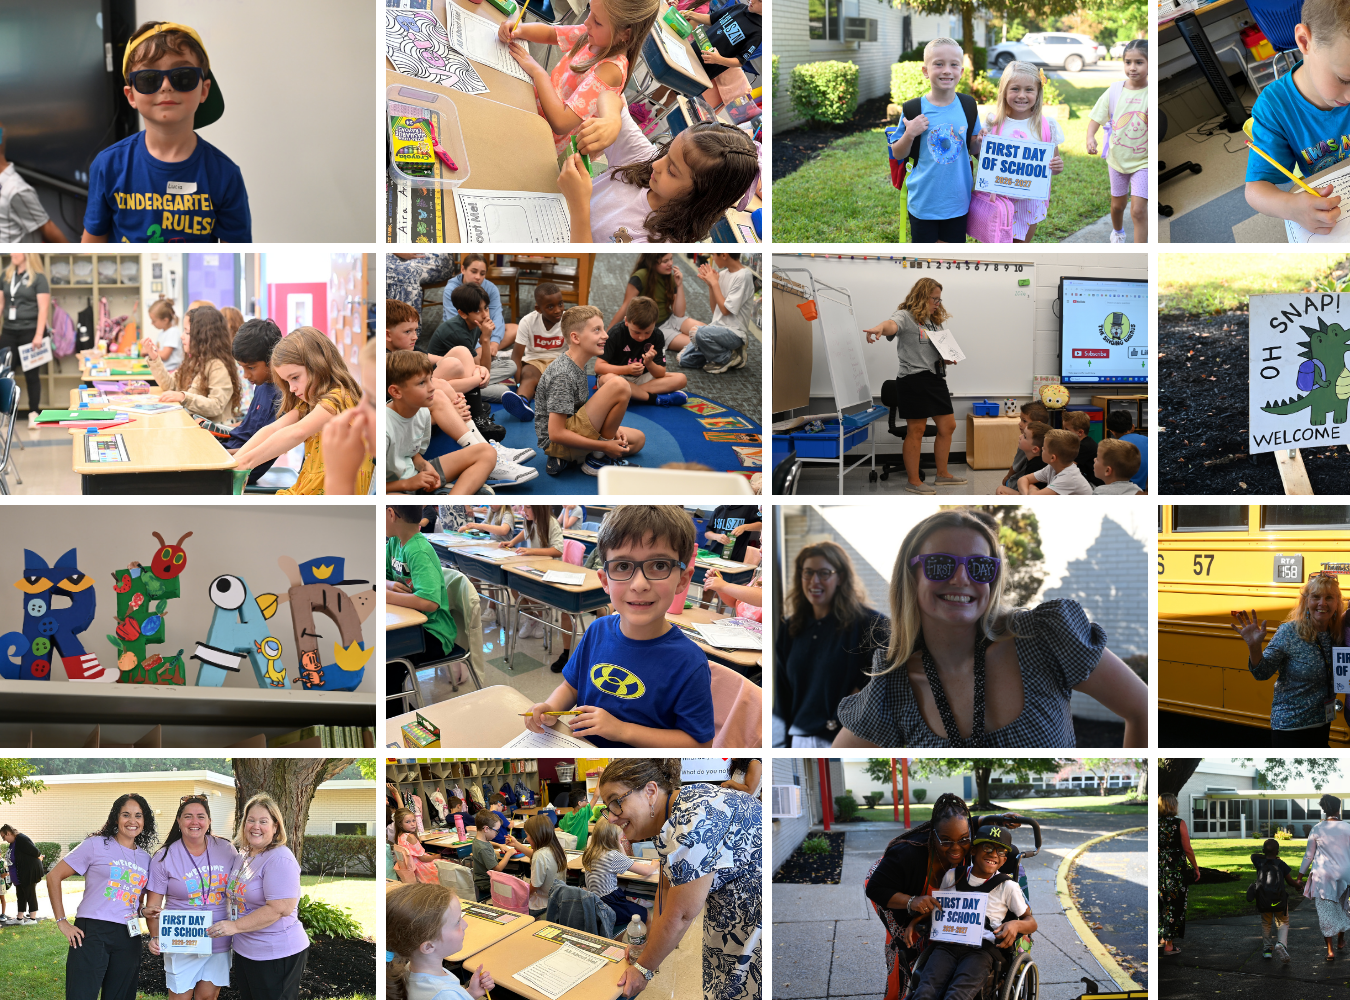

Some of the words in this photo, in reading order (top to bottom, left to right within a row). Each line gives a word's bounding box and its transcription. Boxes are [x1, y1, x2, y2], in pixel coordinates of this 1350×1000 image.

[985, 141, 1020, 158] FIRST
[1022, 147, 1046, 162] DAY
[1308, 139, 1339, 160] WAS
[982, 157, 998, 171] OF
[1000, 160, 1047, 178] SCHOOL
[995, 176, 1032, 188] 2026-2027
[162, 211, 215, 234] RULES!
[398, 208, 408, 234] Aira
[936, 261, 941, 269] 2
[956, 262, 960, 270] 4
[965, 262, 970, 271] 5
[974, 263, 980, 271] 6
[1014, 264, 1023, 272] 10
[1270, 294, 1340, 333] SNAP!
[1103, 336, 1124, 346] SINGING
[1260, 346, 1282, 379] OH
[1253, 426, 1340, 447] WELCOME
[927, 560, 954, 576] FIRST
[972, 562, 993, 576] DAY
[1193, 554, 1214, 576] 57
[1281, 566, 1298, 579] 158
[22, 565, 368, 692] READ
[1336, 666, 1348, 677] OF
[990, 827, 1001, 837] NY
[112, 860, 148, 874] WELCOME
[185, 865, 224, 878] WELCOME
[110, 866, 148, 888] BACK
[185, 874, 228, 893] BACK
[103, 887, 137, 904] SCHOO
[936, 897, 961, 909] FIRST
[962, 898, 980, 910] DAY
[163, 915, 186, 925] FIRST
[189, 916, 205, 926] DAY
[935, 910, 946, 921] OF
[947, 911, 981, 925] SCHOOL
[161, 927, 172, 937] OF
[174, 927, 208, 938] SCHOOL
